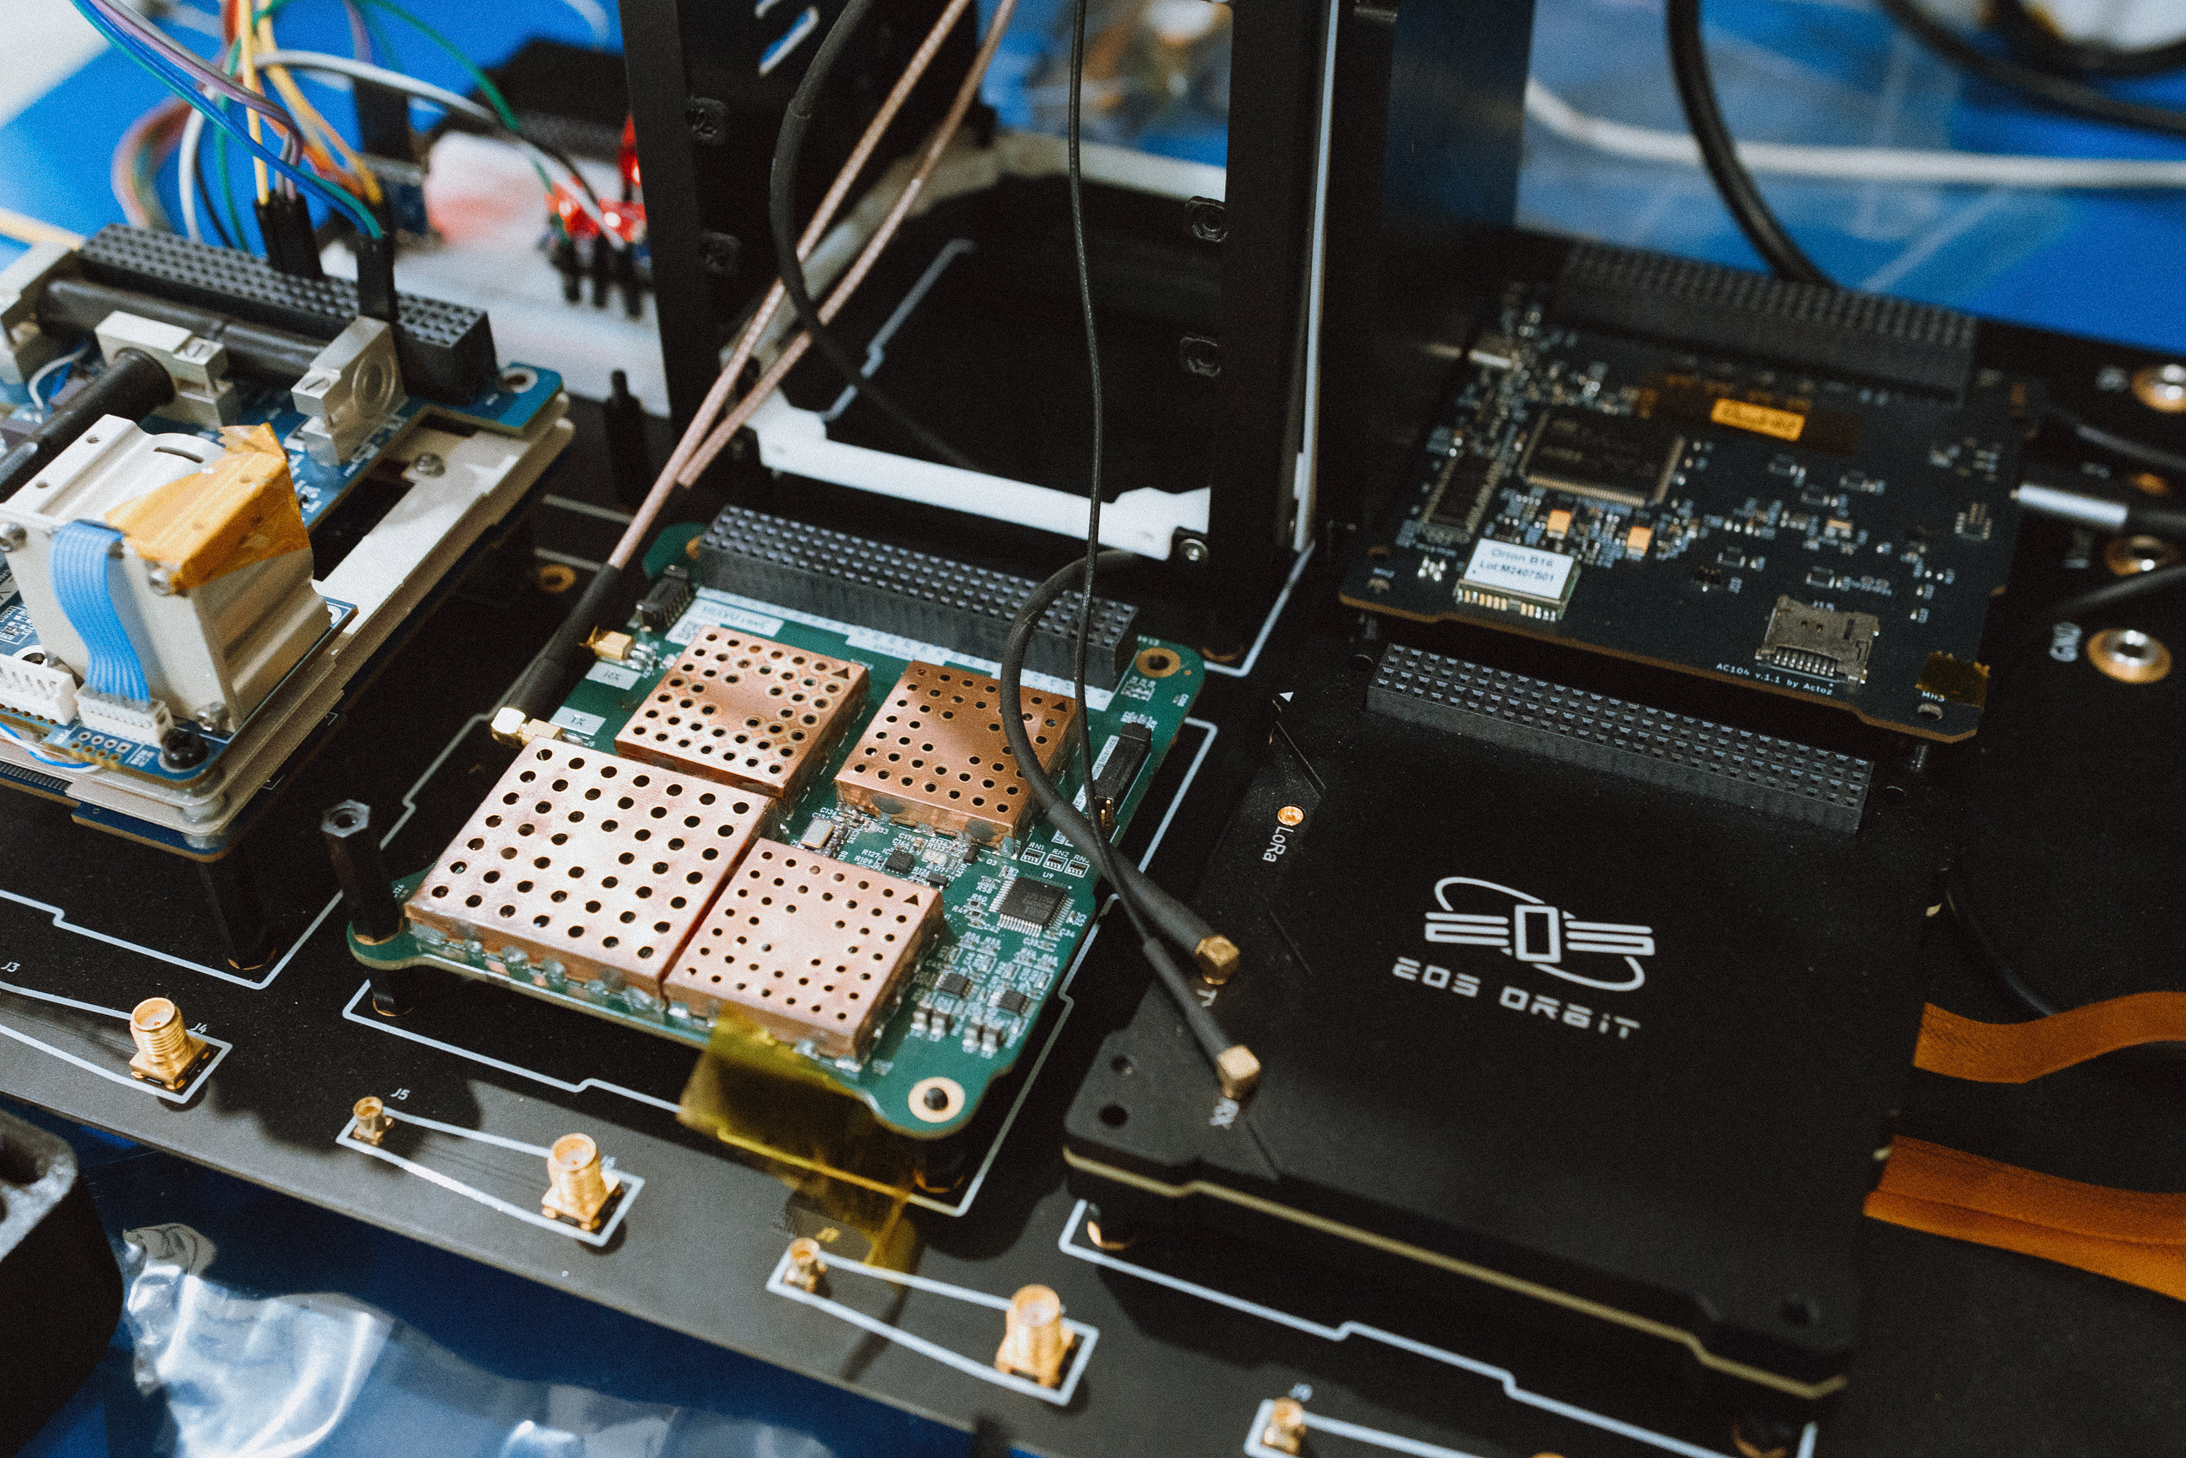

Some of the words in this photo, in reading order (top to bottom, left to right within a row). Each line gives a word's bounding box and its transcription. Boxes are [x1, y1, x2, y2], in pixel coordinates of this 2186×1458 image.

[1716, 663, 1750, 678] AC104
[1786, 679, 1799, 690] by
[1028, 841, 1044, 851] RN1
[1262, 825, 1295, 863] LoRa
[1052, 848, 1068, 858] RN2
[854, 855, 873, 865] R109
[1042, 871, 1054, 879] U9
[190, 1022, 208, 1034] J4
[390, 1087, 410, 1100] J5
